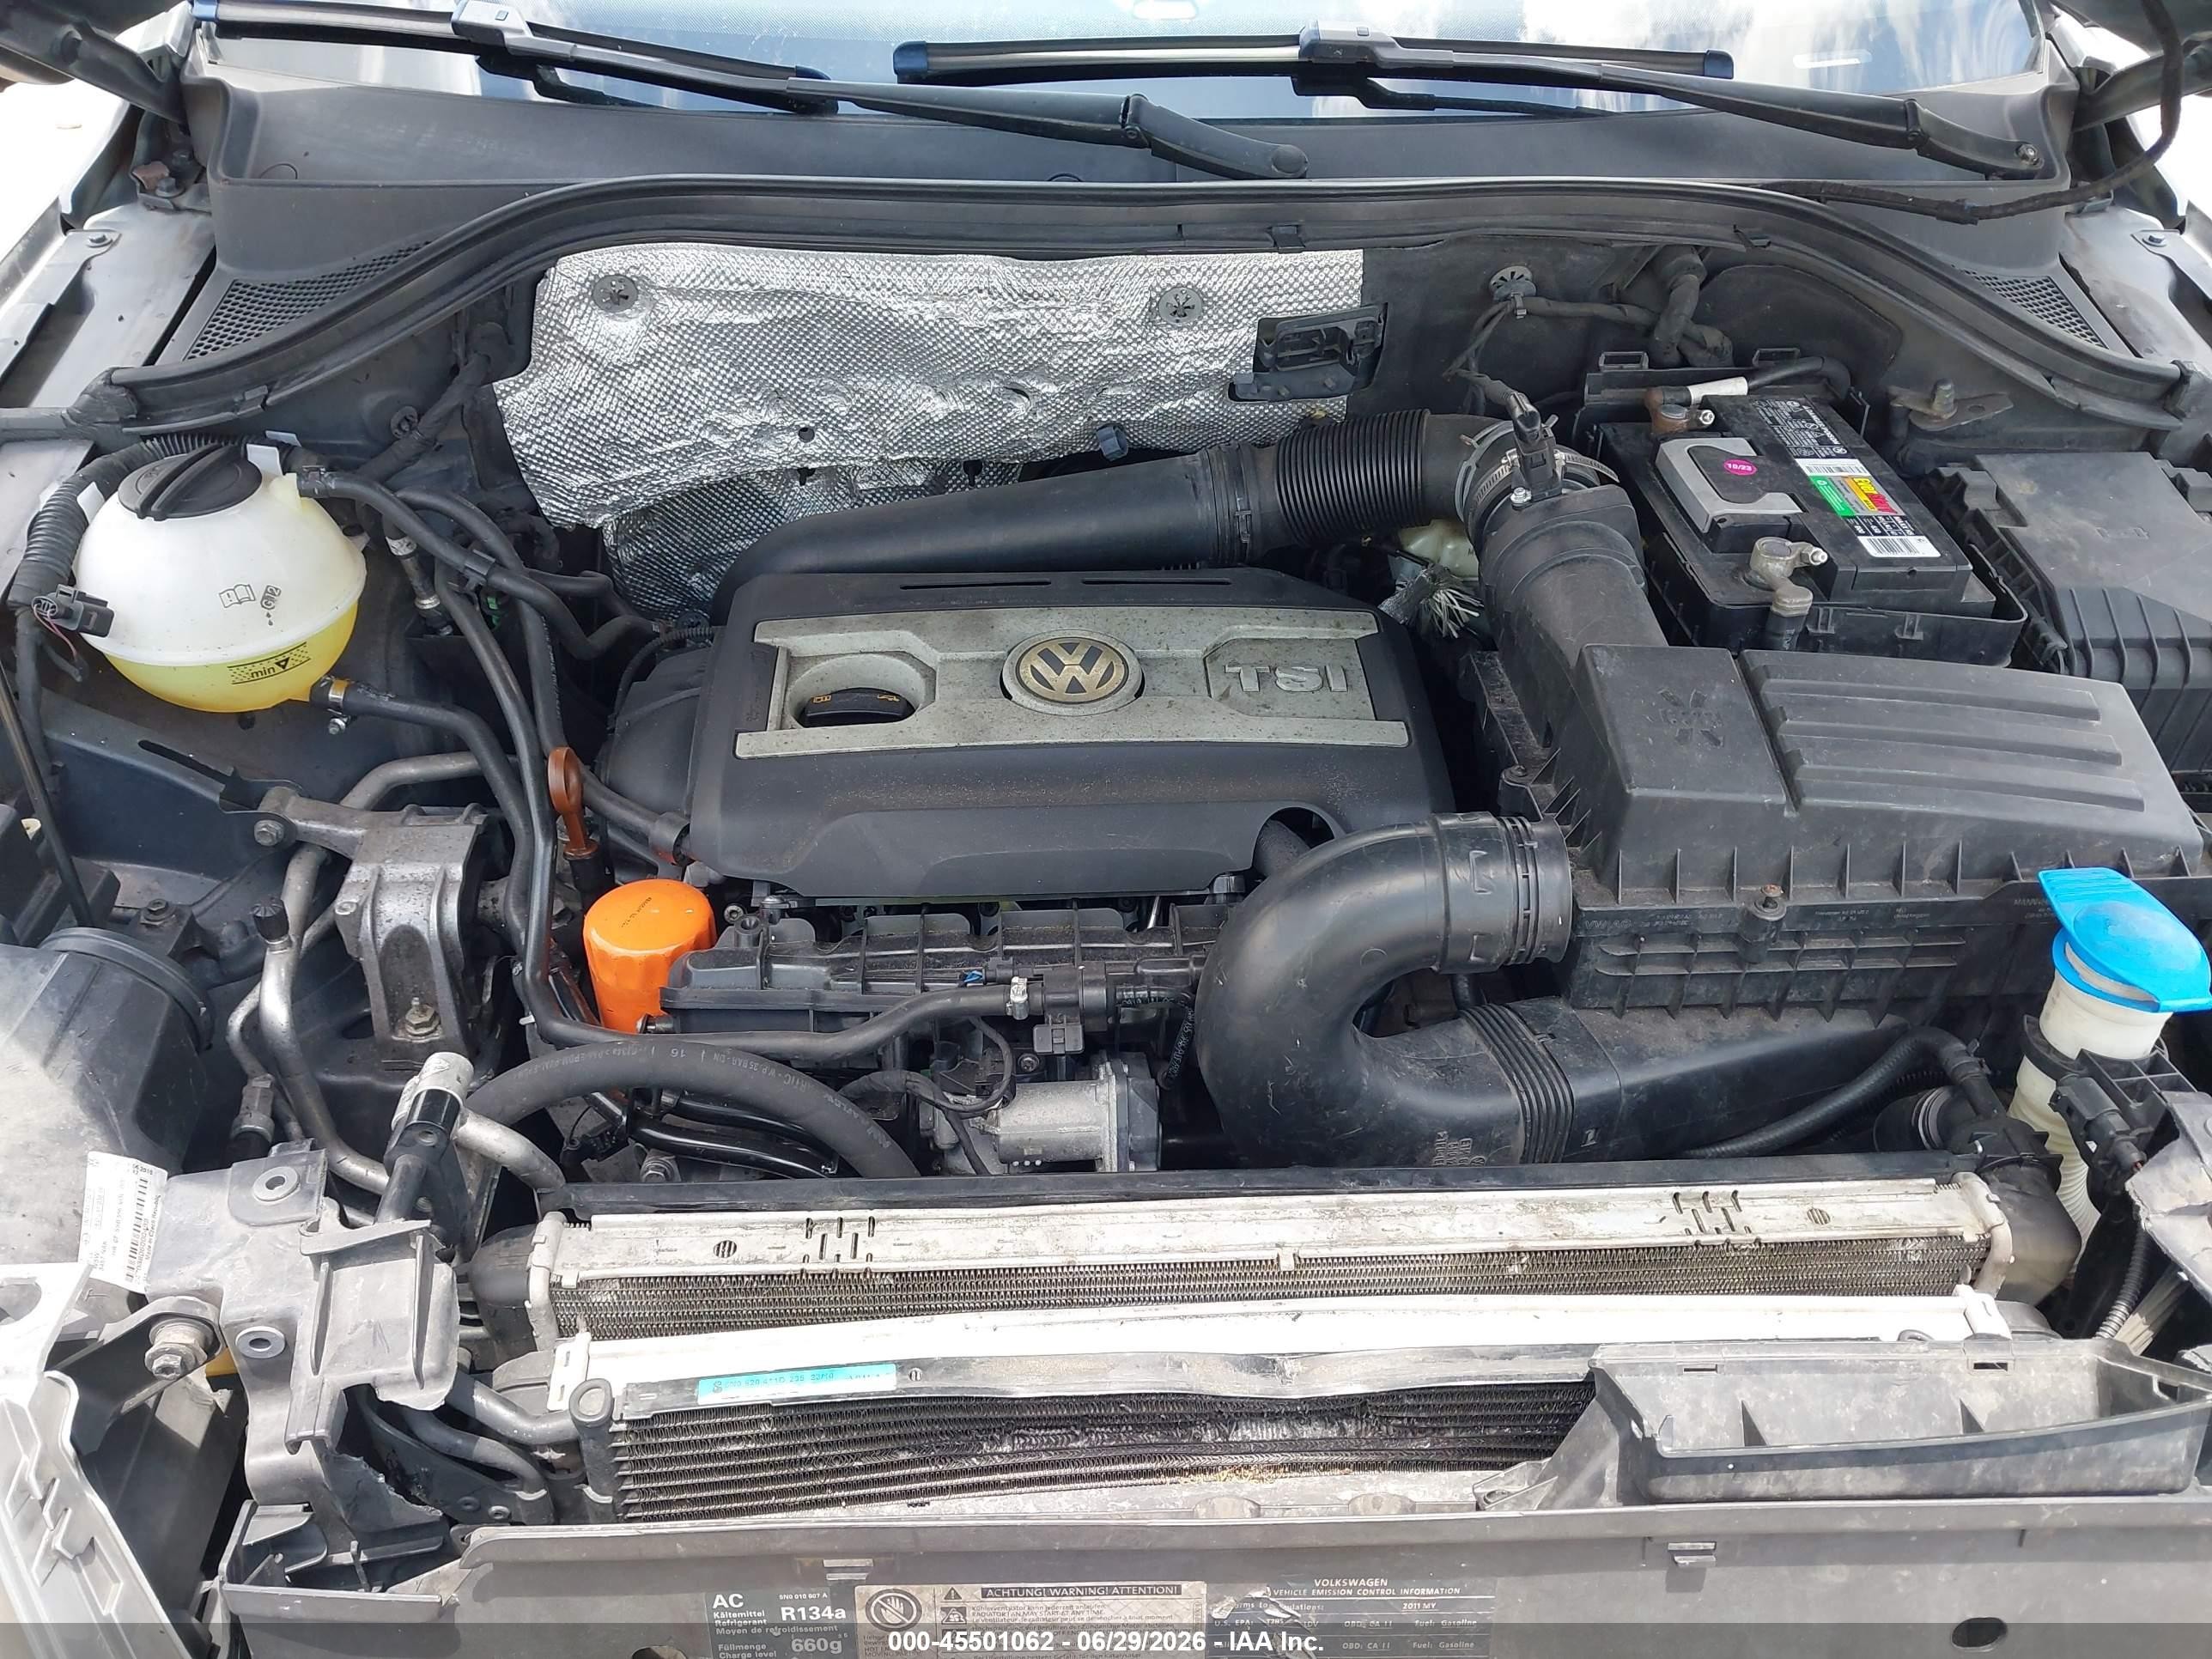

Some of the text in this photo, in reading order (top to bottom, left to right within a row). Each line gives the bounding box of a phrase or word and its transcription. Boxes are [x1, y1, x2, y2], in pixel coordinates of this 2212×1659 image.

[250, 665, 276, 678] min
[1224, 664, 1349, 693] TSI
[1314, 1578, 1389, 1587] VOLKSWAGEN
[987, 1585, 1178, 1598] ACHTUNG! WARNING! ATTENTION!
[1400, 1587, 1461, 1595] INFORMATION
[713, 1594, 744, 1608] AC
[714, 1610, 766, 1619] Kältemittel
[781, 1606, 847, 1621] R134a
[1441, 1619, 1478, 1627] Gasoline
[716, 1624, 839, 1636] Moyen de refroidissement
[718, 1643, 767, 1653] Füllmenge
[791, 1638, 843, 1654] 660g
[719, 1650, 777, 1659] Charge level
